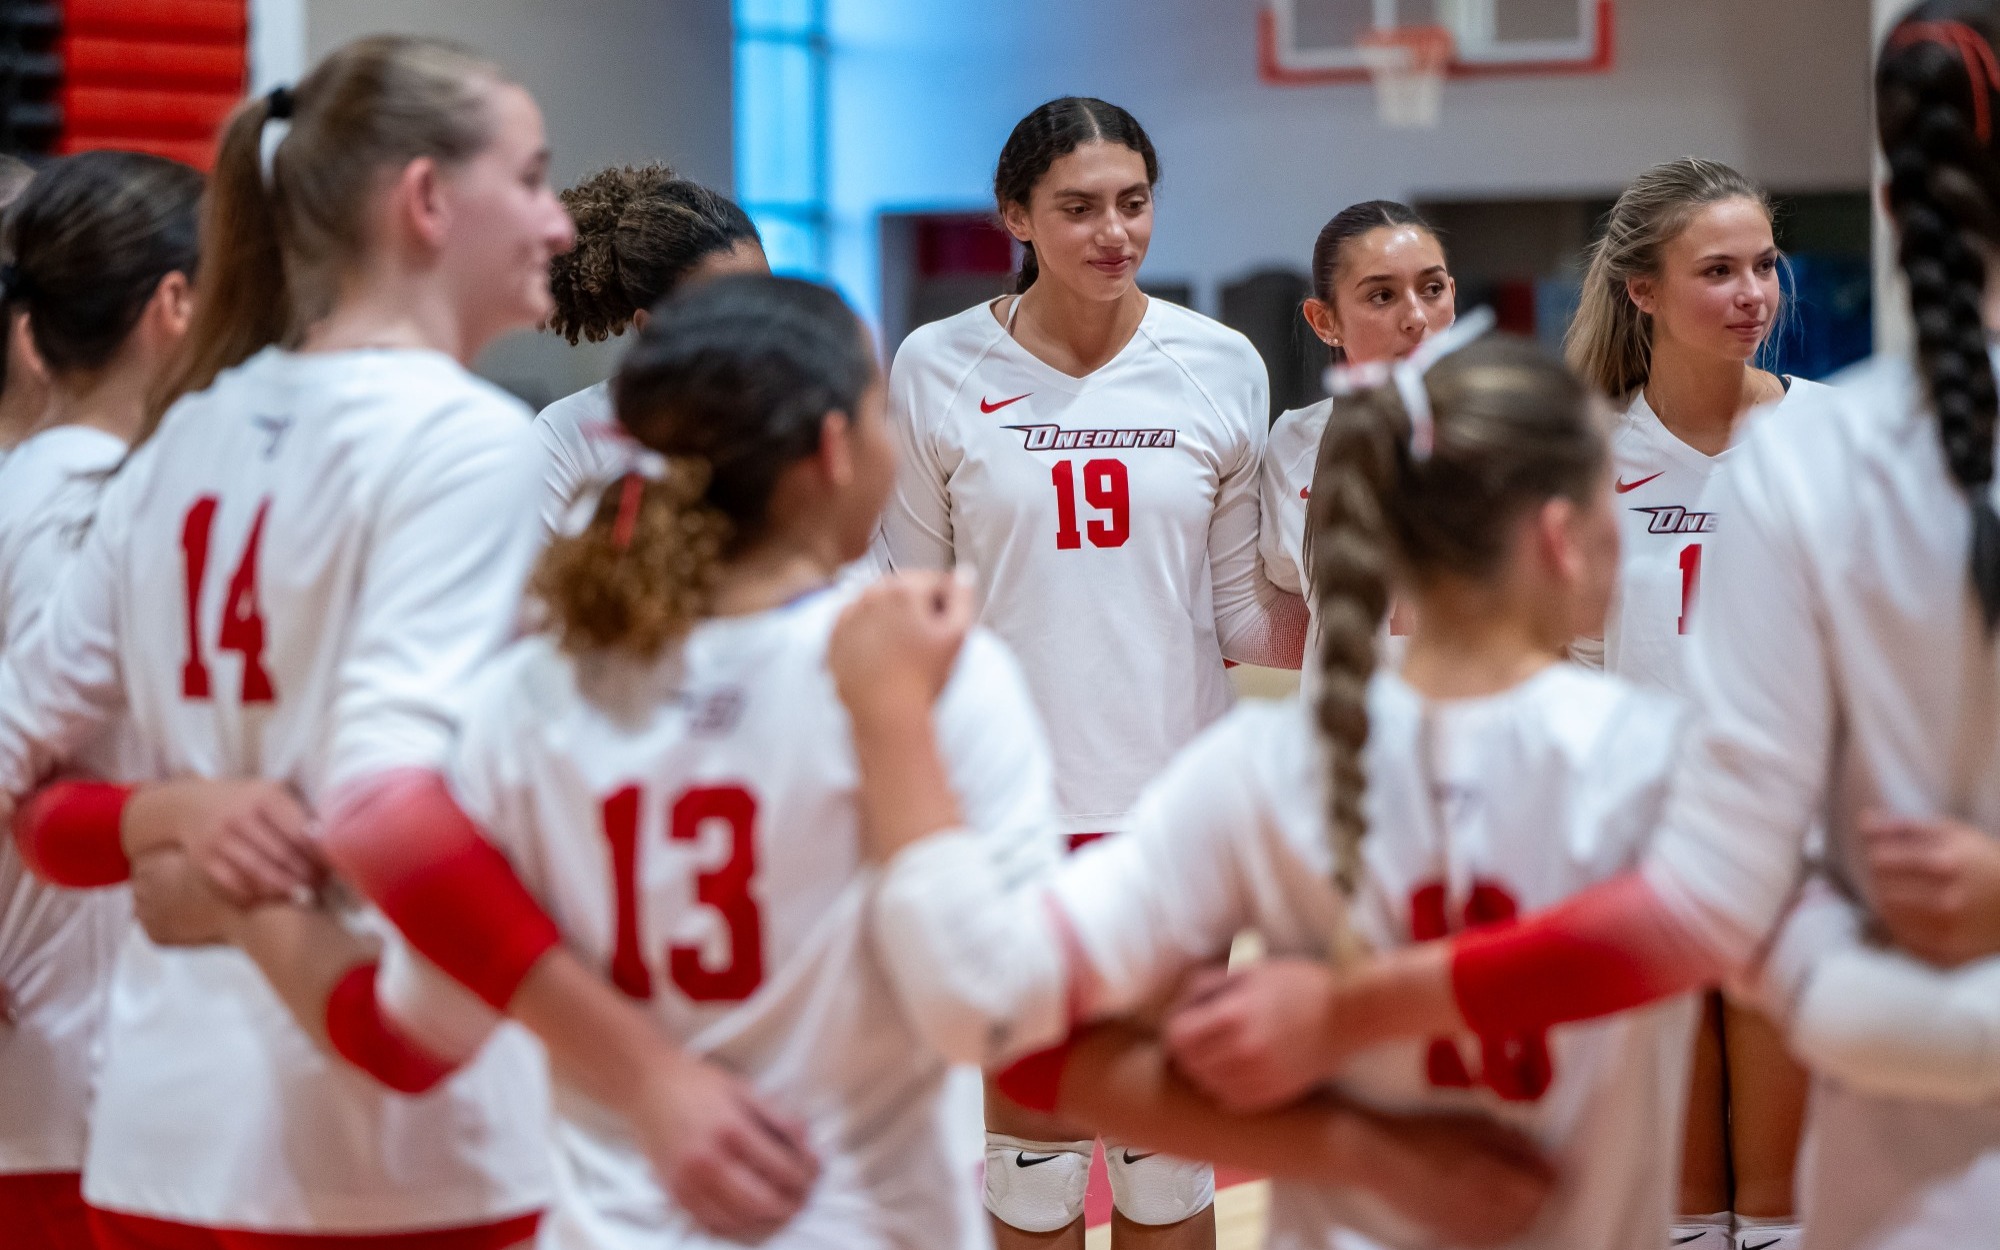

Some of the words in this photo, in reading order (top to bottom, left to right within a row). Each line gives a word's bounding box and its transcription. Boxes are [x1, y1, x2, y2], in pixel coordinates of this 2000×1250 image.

[179, 493, 276, 705] 14
[1052, 458, 1130, 549] 19
[601, 783, 762, 1003] 13
